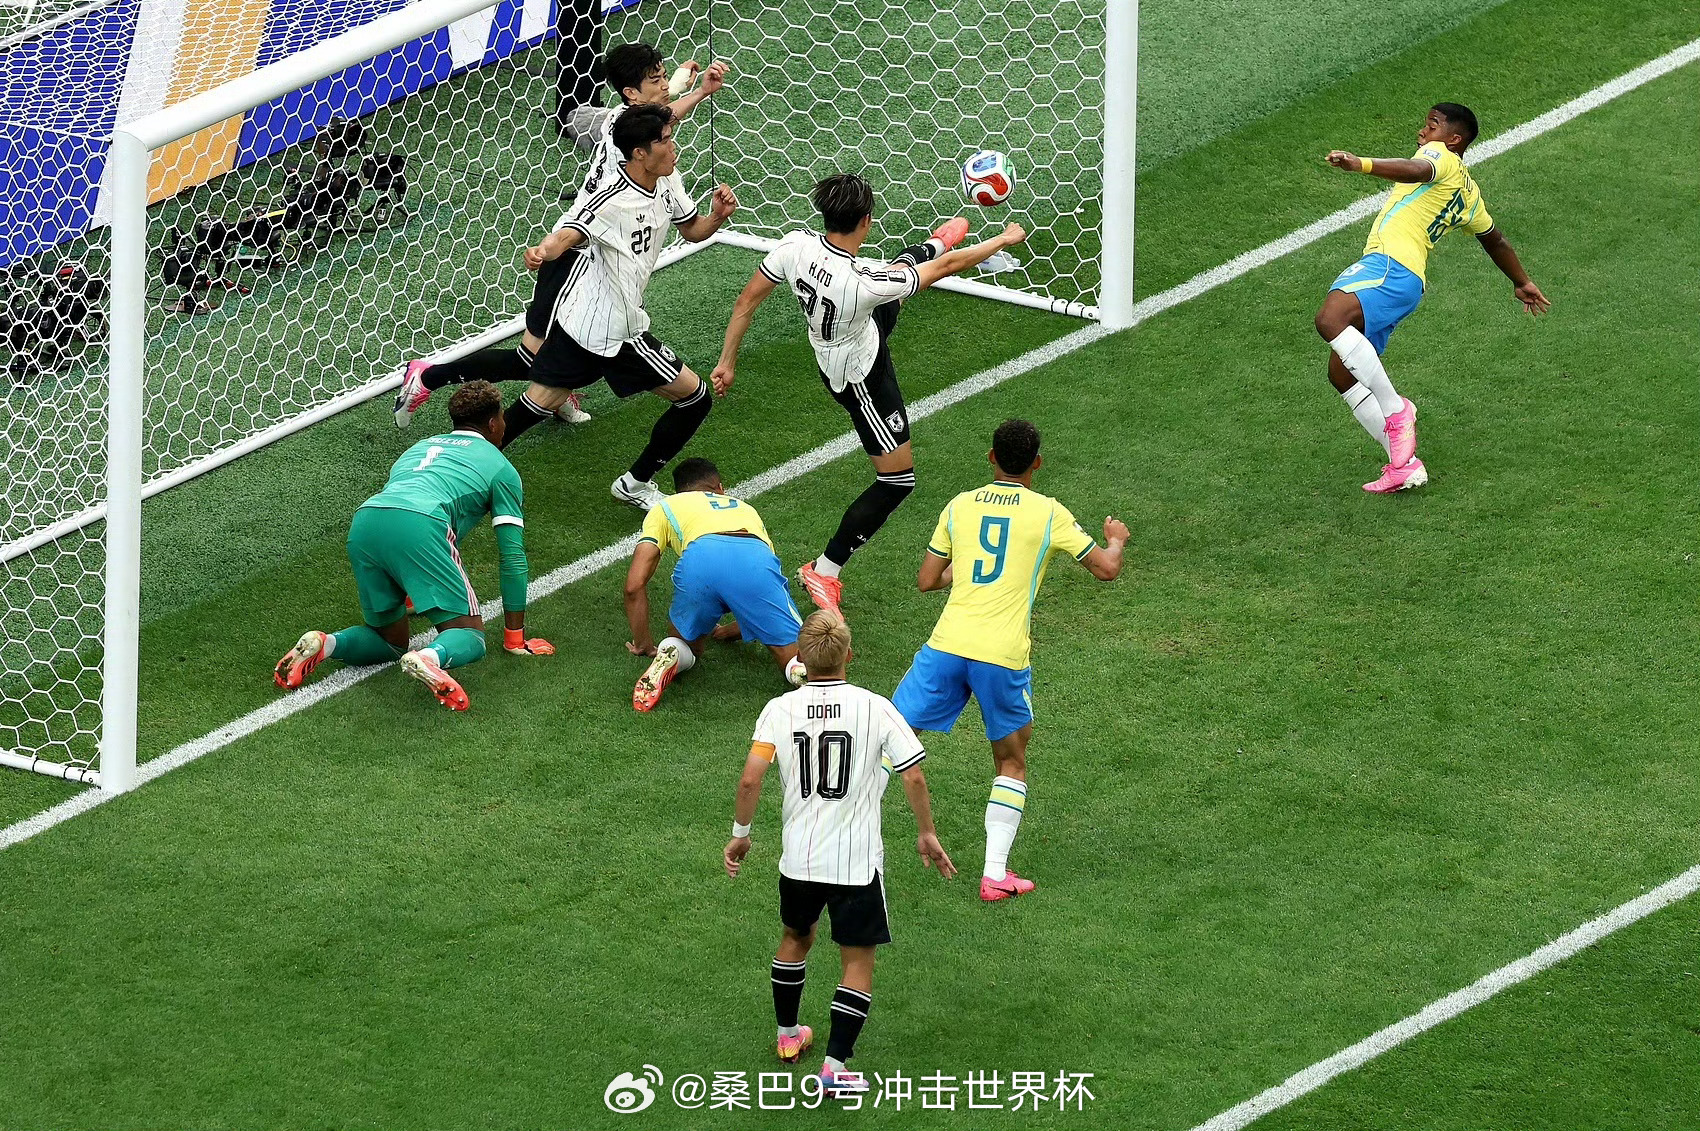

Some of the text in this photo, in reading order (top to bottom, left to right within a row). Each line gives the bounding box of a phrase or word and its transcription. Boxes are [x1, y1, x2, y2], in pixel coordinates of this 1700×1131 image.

[631, 225, 652, 255] 22
[795, 277, 838, 341] 21
[412, 445, 445, 472] 1
[974, 490, 1021, 506] CUNHA
[971, 515, 1011, 584] 9
[807, 703, 841, 720] DOAN
[793, 730, 855, 801] 10
